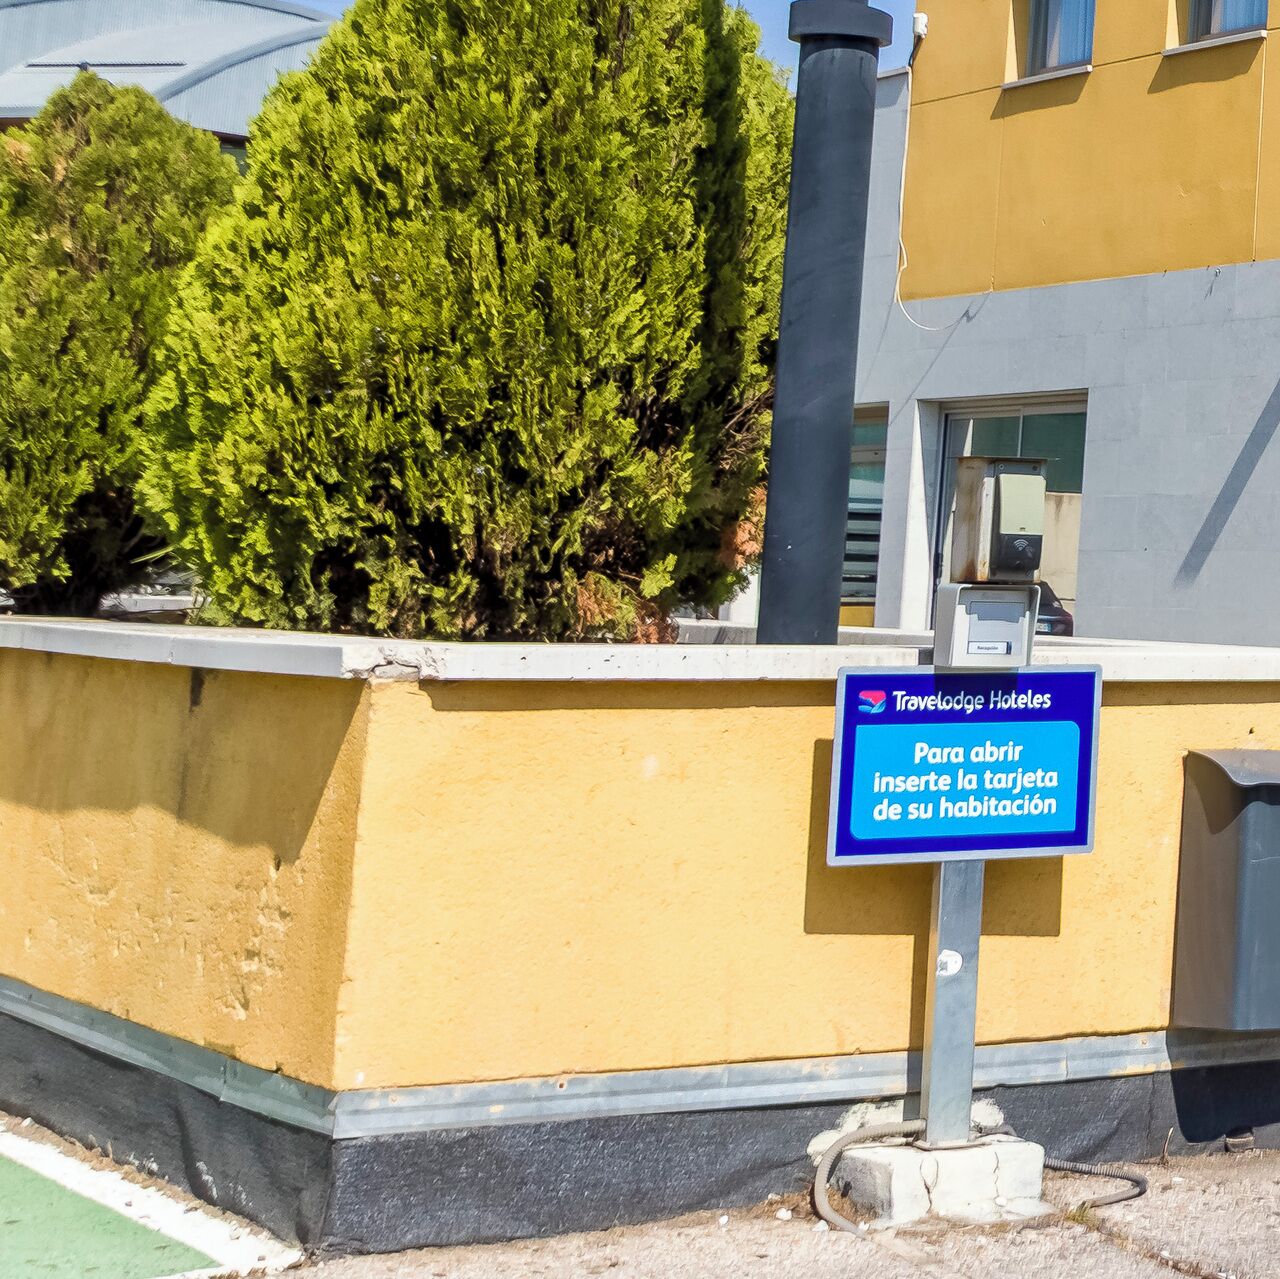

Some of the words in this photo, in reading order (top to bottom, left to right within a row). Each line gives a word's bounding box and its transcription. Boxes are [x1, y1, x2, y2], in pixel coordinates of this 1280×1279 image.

[893, 690, 984, 713] Travelodge
[989, 689, 1051, 709] Hoteles
[914, 742, 965, 764] Para
[969, 740, 1023, 763] abrir
[873, 772, 952, 793] inserte
[957, 768, 978, 791] la
[983, 768, 1059, 795] tarjeta
[872, 798, 903, 821] de
[907, 803, 934, 820] su
[939, 793, 1057, 819] habitación
